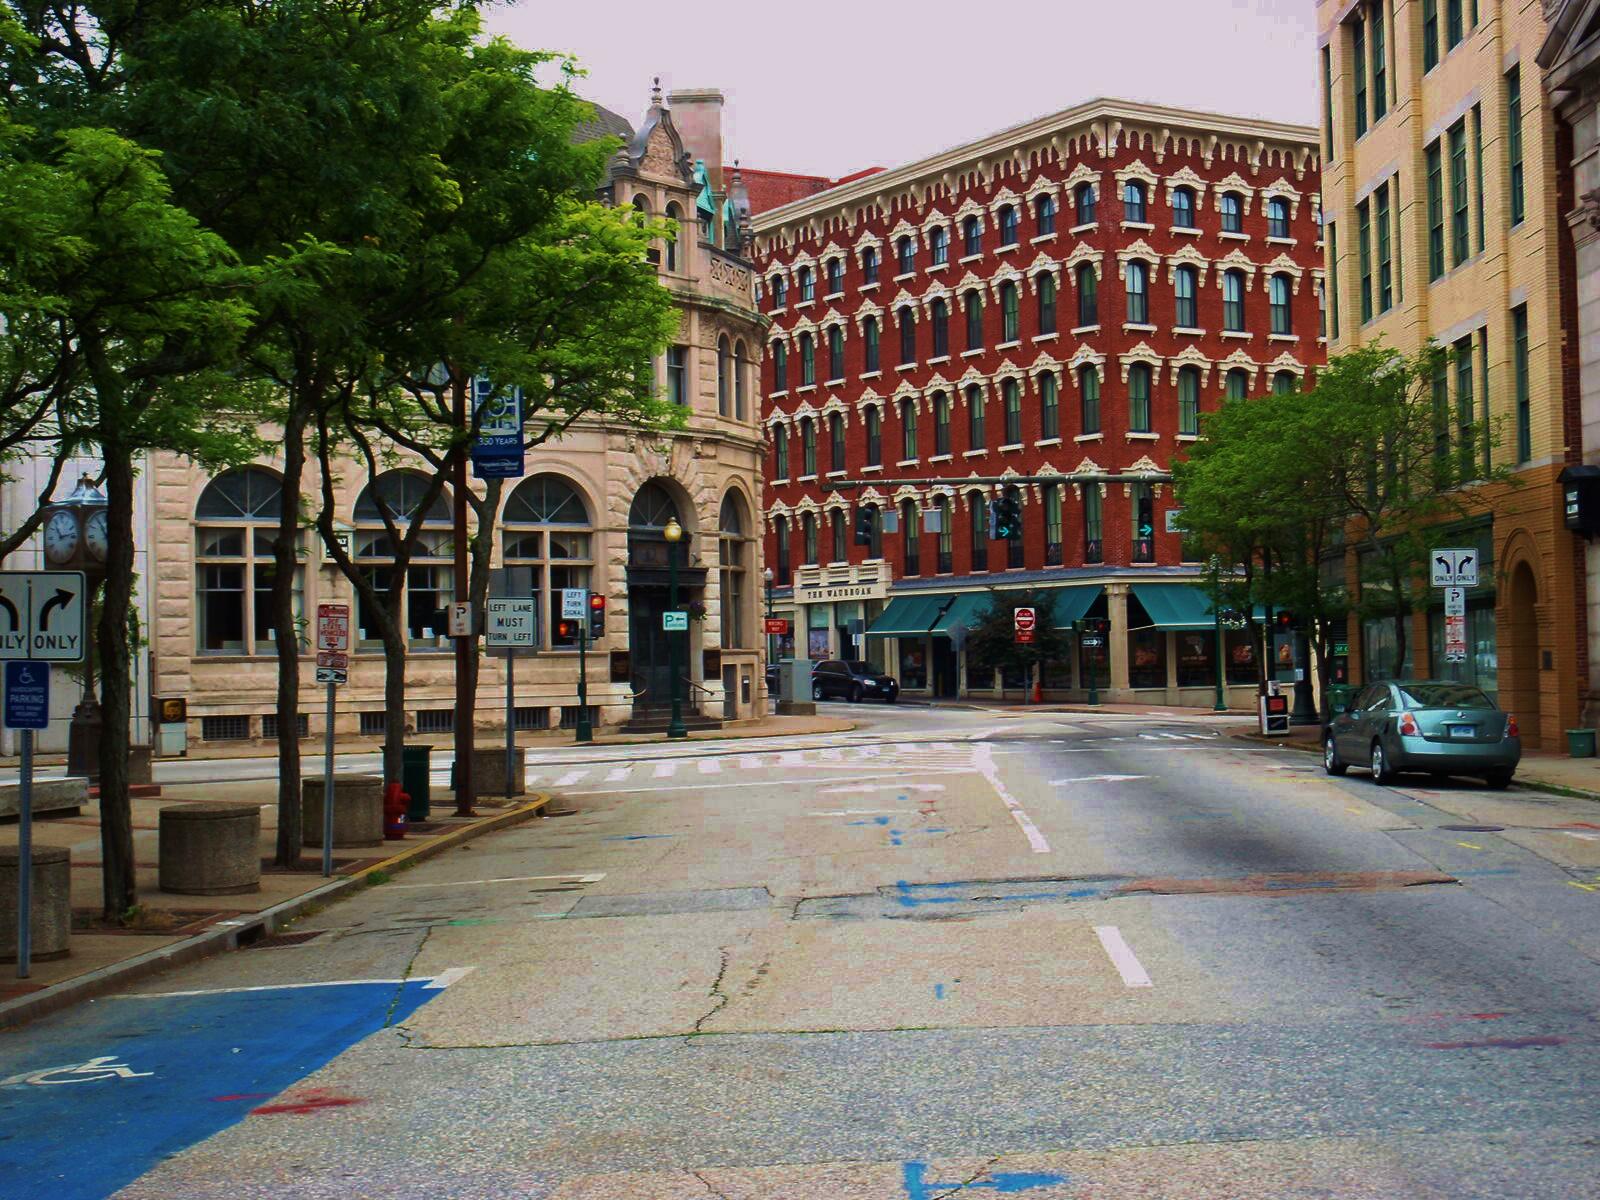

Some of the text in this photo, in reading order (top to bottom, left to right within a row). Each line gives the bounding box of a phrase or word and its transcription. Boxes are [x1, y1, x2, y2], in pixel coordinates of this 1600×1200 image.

[495, 437, 518, 446] YEARS
[566, 591, 582, 599] LEFT
[807, 587, 872, 599] THE WAUREGAN
[489, 604, 532, 613] LEFT LANE
[496, 617, 523, 628] MUST
[488, 632, 532, 641] TURN LEFT
[0, 634, 78, 649] LY ONLY
[9, 694, 44, 704] PARKING
